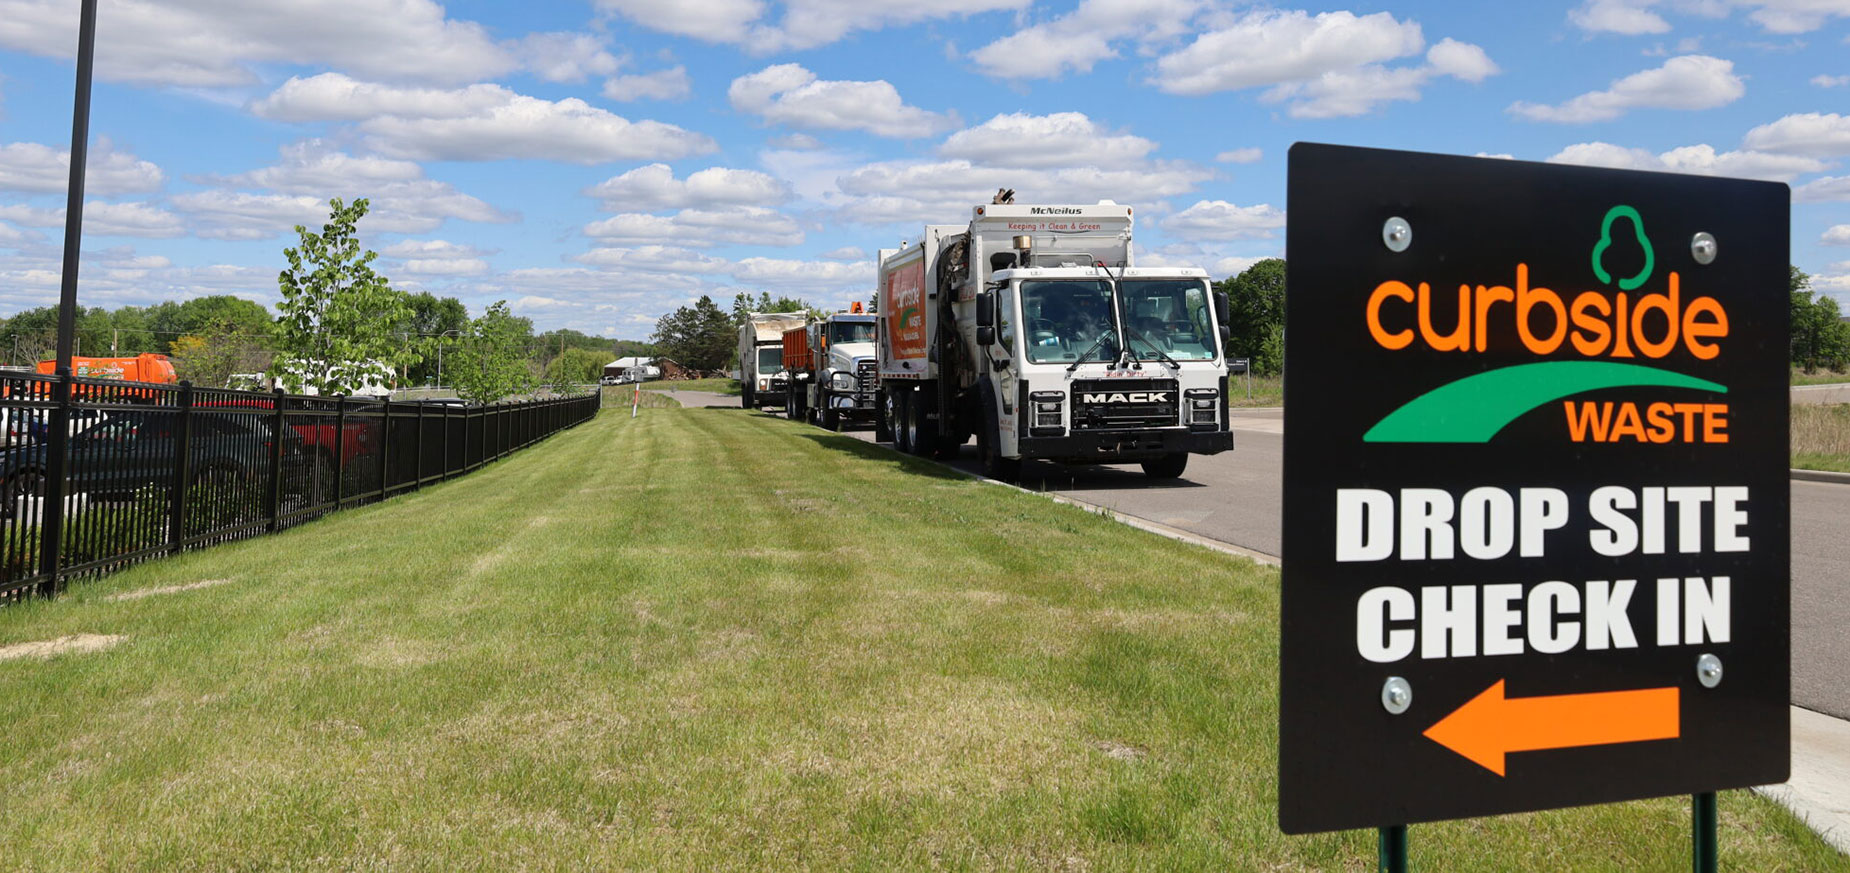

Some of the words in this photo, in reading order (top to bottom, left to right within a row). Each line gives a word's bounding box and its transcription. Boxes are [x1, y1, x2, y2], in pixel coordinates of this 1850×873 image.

[1008, 222, 1036, 231] Keeping
[1048, 222, 1067, 230] Clean
[1079, 222, 1101, 230] Green
[1030, 207, 1082, 215] McNeilus
[1366, 263, 1728, 359] curbside
[1083, 393, 1168, 404] MACK
[1564, 401, 1729, 443] WASTE
[1336, 487, 1570, 562] DROP
[1589, 485, 1750, 556] SITE
[1356, 579, 1638, 663] CHECK
[1656, 576, 1731, 646] IN
